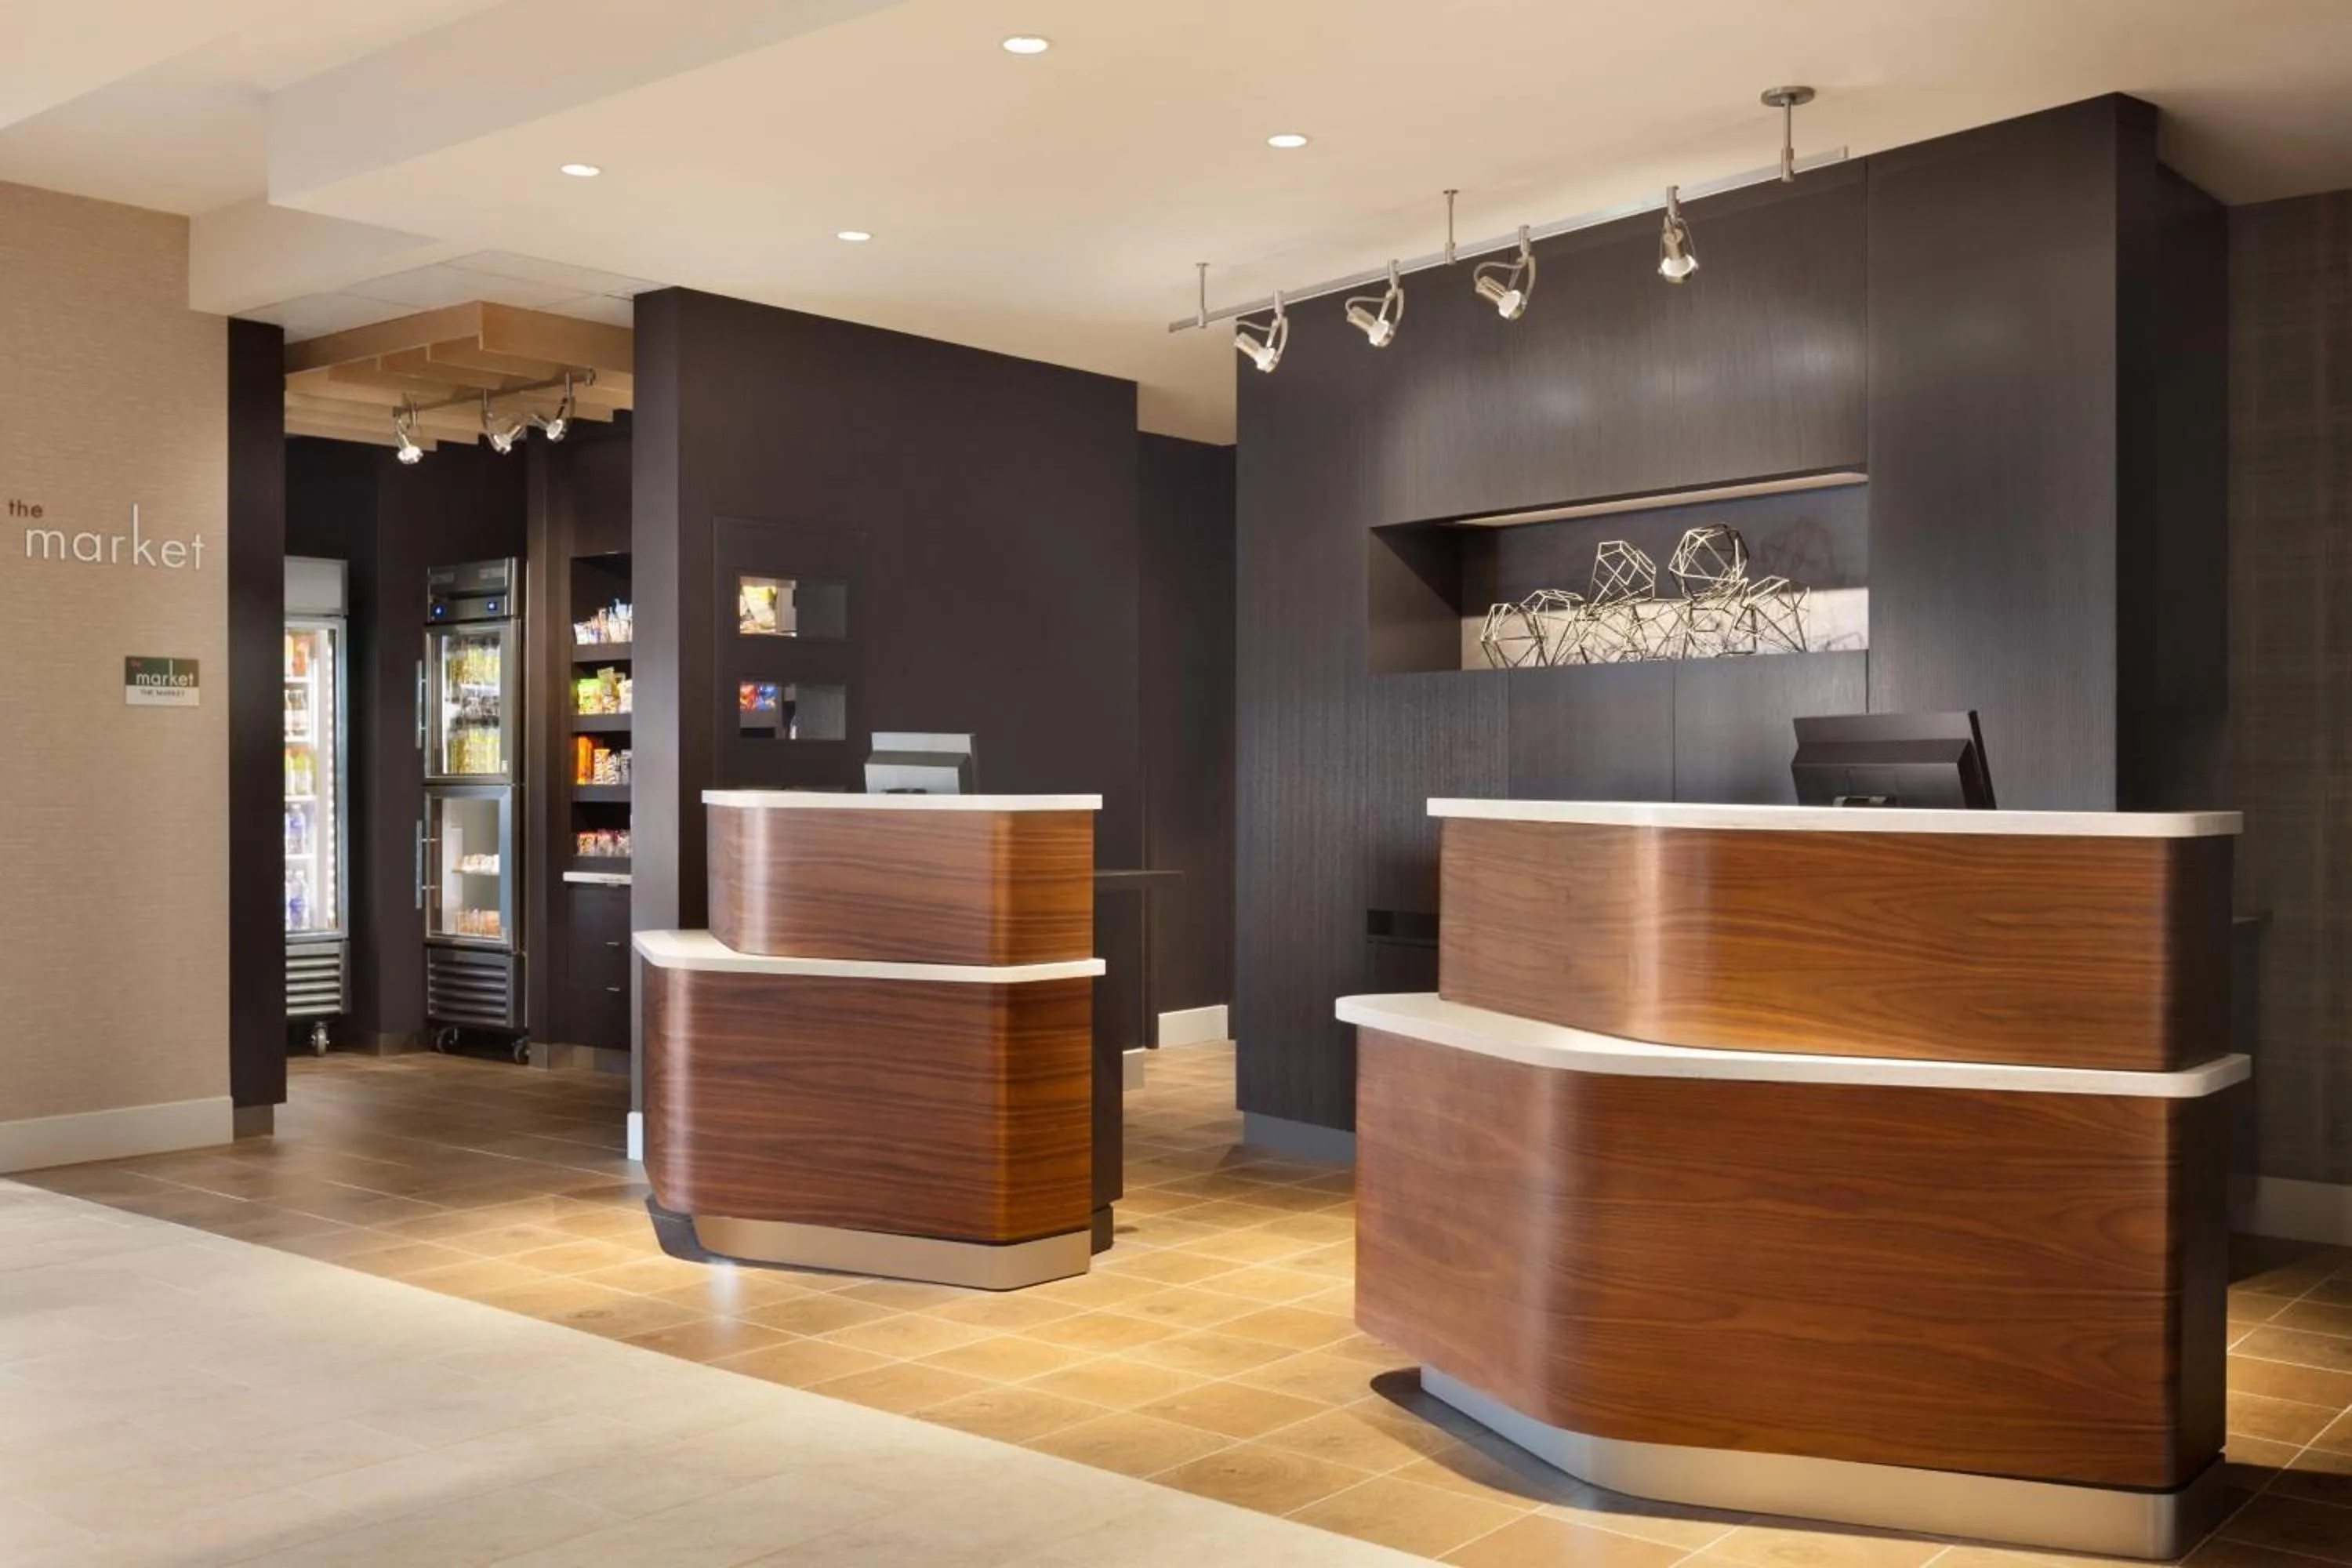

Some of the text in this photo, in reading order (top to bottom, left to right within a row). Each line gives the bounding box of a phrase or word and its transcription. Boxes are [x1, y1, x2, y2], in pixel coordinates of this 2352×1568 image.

[9, 499, 43, 518] the
[26, 503, 205, 570] market
[136, 659, 194, 687] market
